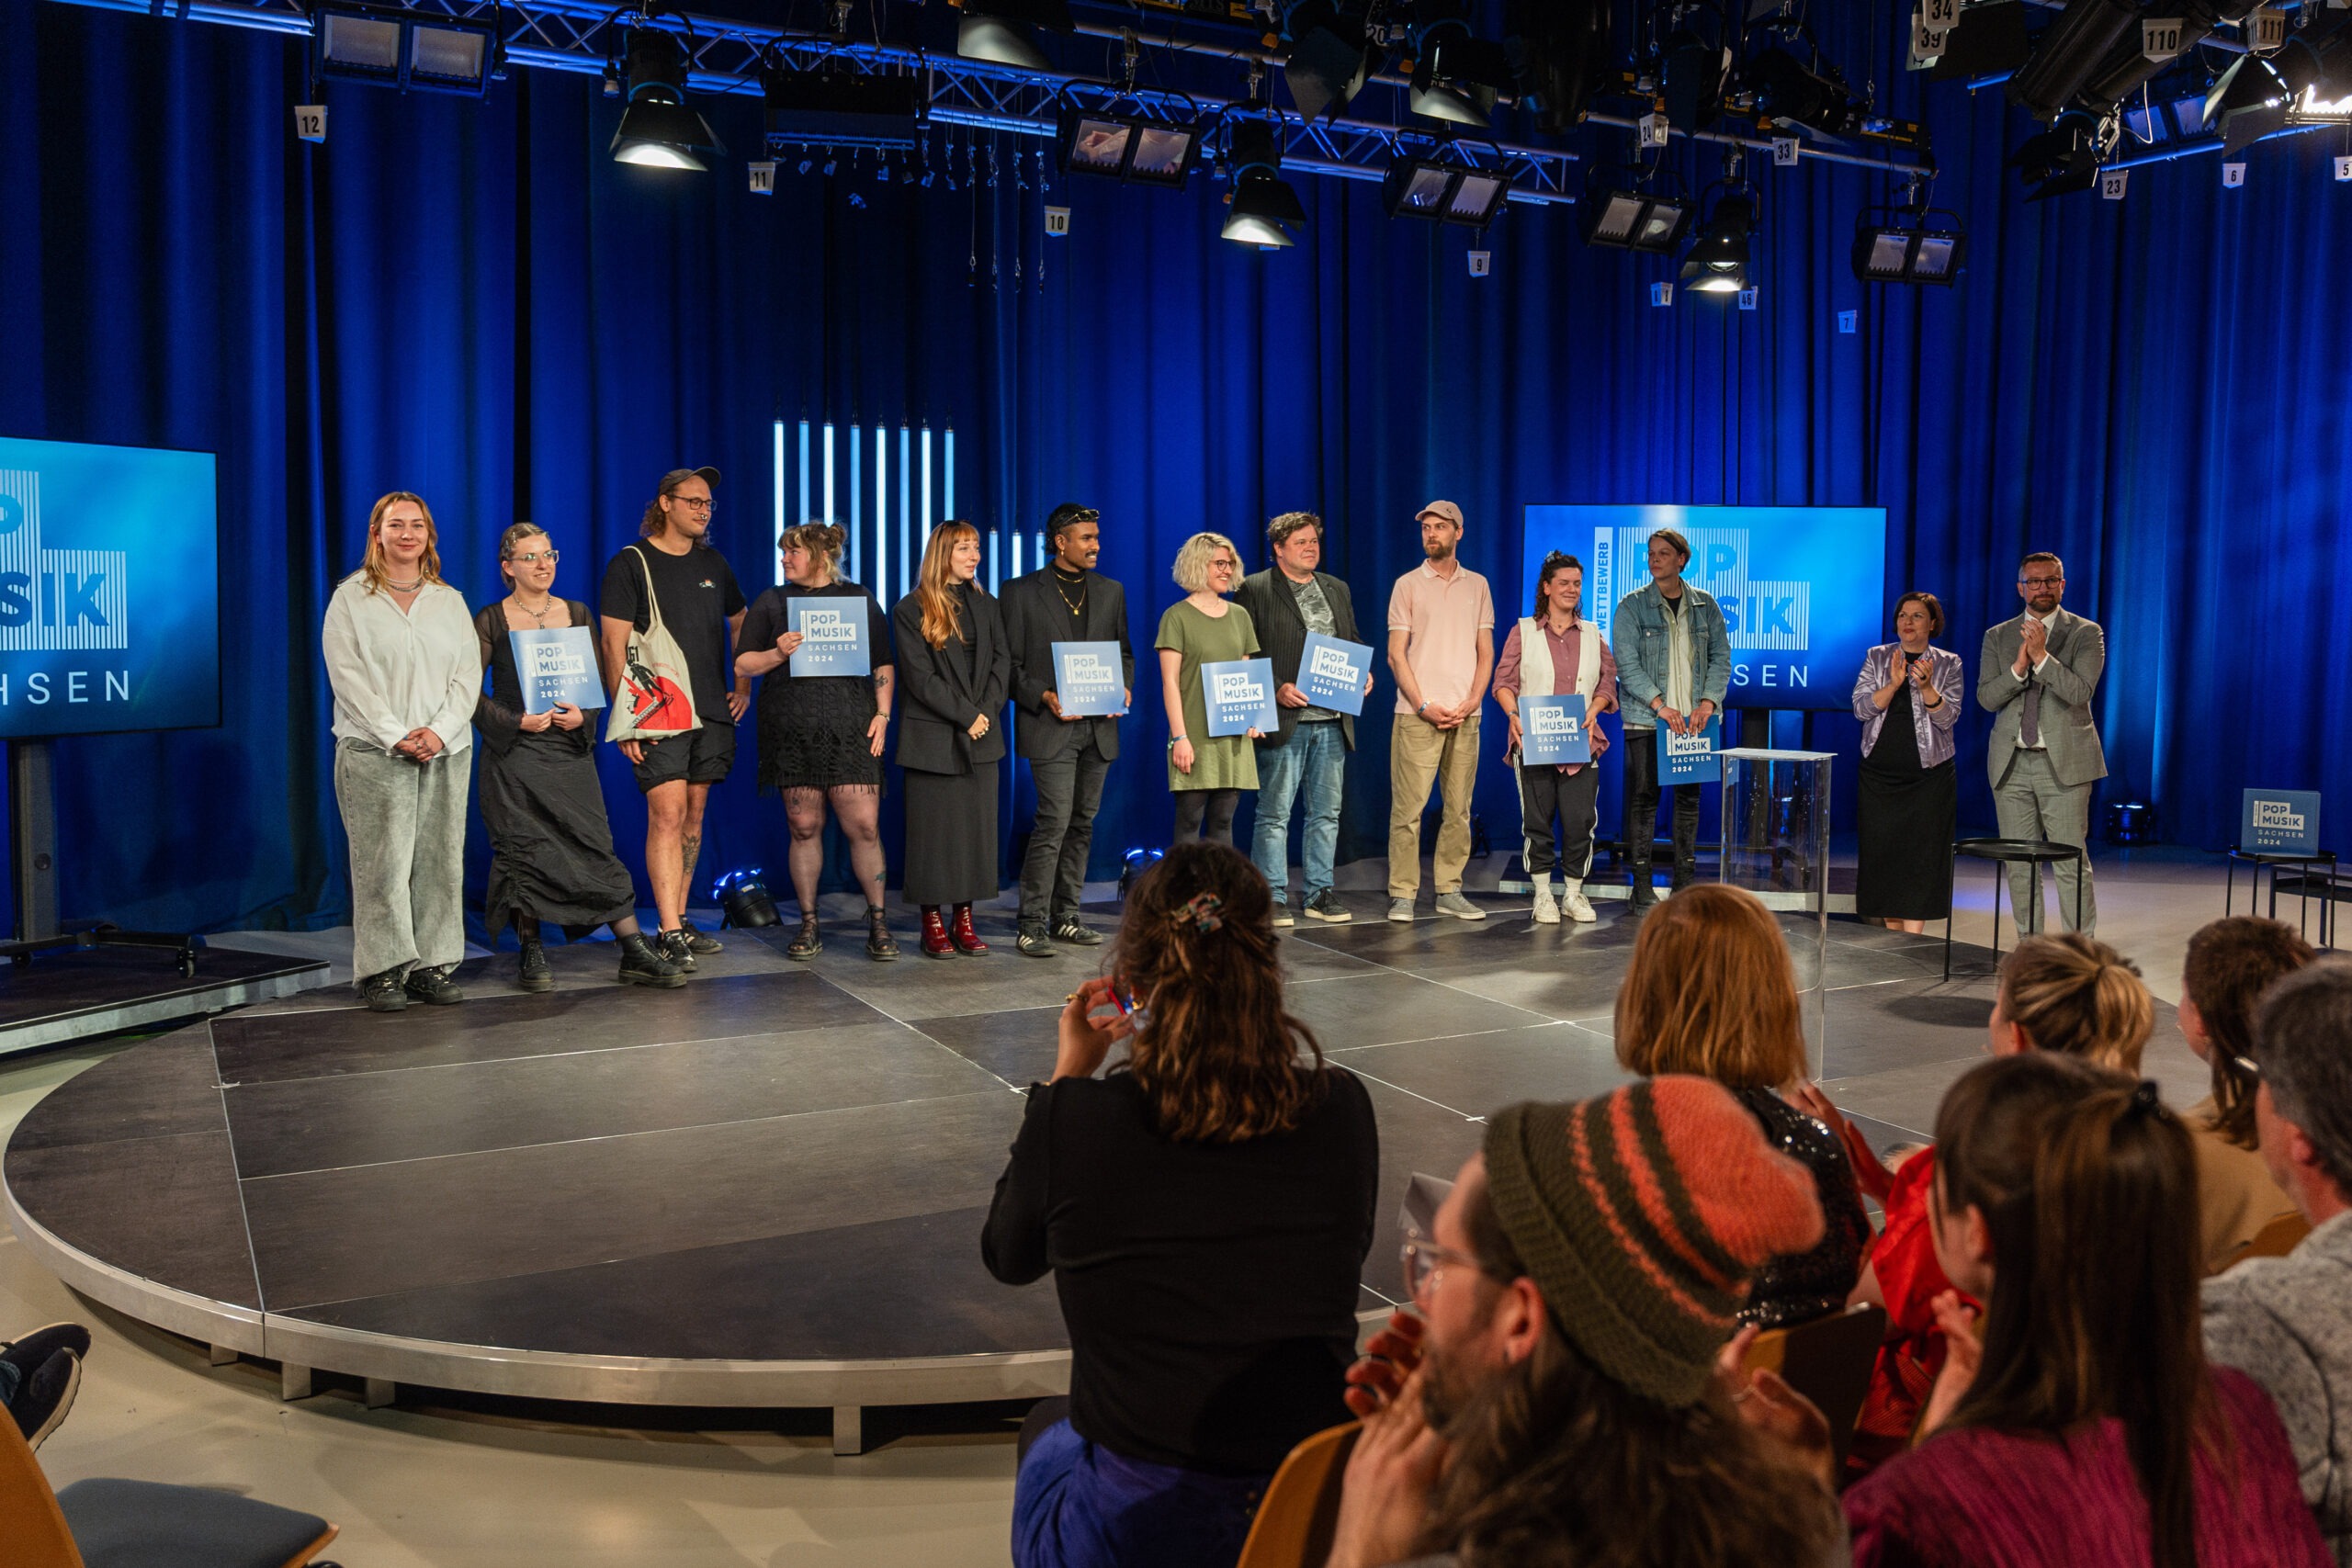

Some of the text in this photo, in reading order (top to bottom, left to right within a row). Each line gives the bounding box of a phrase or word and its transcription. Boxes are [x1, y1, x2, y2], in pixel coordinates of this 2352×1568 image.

[1931, 0, 1952, 19] 34
[2262, 19, 2282, 40] 111
[1921, 27, 1940, 48] 39
[2147, 29, 2177, 51] 110
[302, 115, 320, 133] 12
[1643, 124, 1651, 141] 24
[1778, 143, 1790, 160] 33
[2343, 164, 2349, 175] 5
[754, 171, 765, 186] 11
[2231, 170, 2237, 182] 6
[2107, 179, 2120, 194] 23
[1050, 215, 1063, 230] 10
[1476, 258, 1482, 272] 9
[1597, 542, 1609, 630] WETTBEWERB
[809, 615, 836, 624] POP
[811, 627, 852, 637] MUSIK
[537, 647, 562, 658] POP
[1323, 651, 1345, 663] POP
[539, 660, 581, 671] MUSIK
[1073, 658, 1095, 667] POP
[1075, 670, 1109, 680] MUSIK
[1319, 663, 1354, 679] MUSIK
[538, 677, 588, 687] SACHSEN
[1223, 677, 1245, 686] POP
[1313, 676, 1356, 692] SACHSEN
[541, 690, 565, 698] 2024
[1224, 688, 1260, 699] MUSIK
[1311, 685, 1333, 696] 2024
[1222, 703, 1265, 712] SACHSEN
[1539, 710, 1561, 719] POP
[1540, 721, 1574, 730] MUSIK
[1675, 741, 1707, 751] MUSIK
[1672, 755, 1712, 763] SACHSEN
[2263, 805, 2287, 814] POP
[2262, 816, 2301, 826] MUSIK
[2257, 829, 2304, 839] SACHSEN
